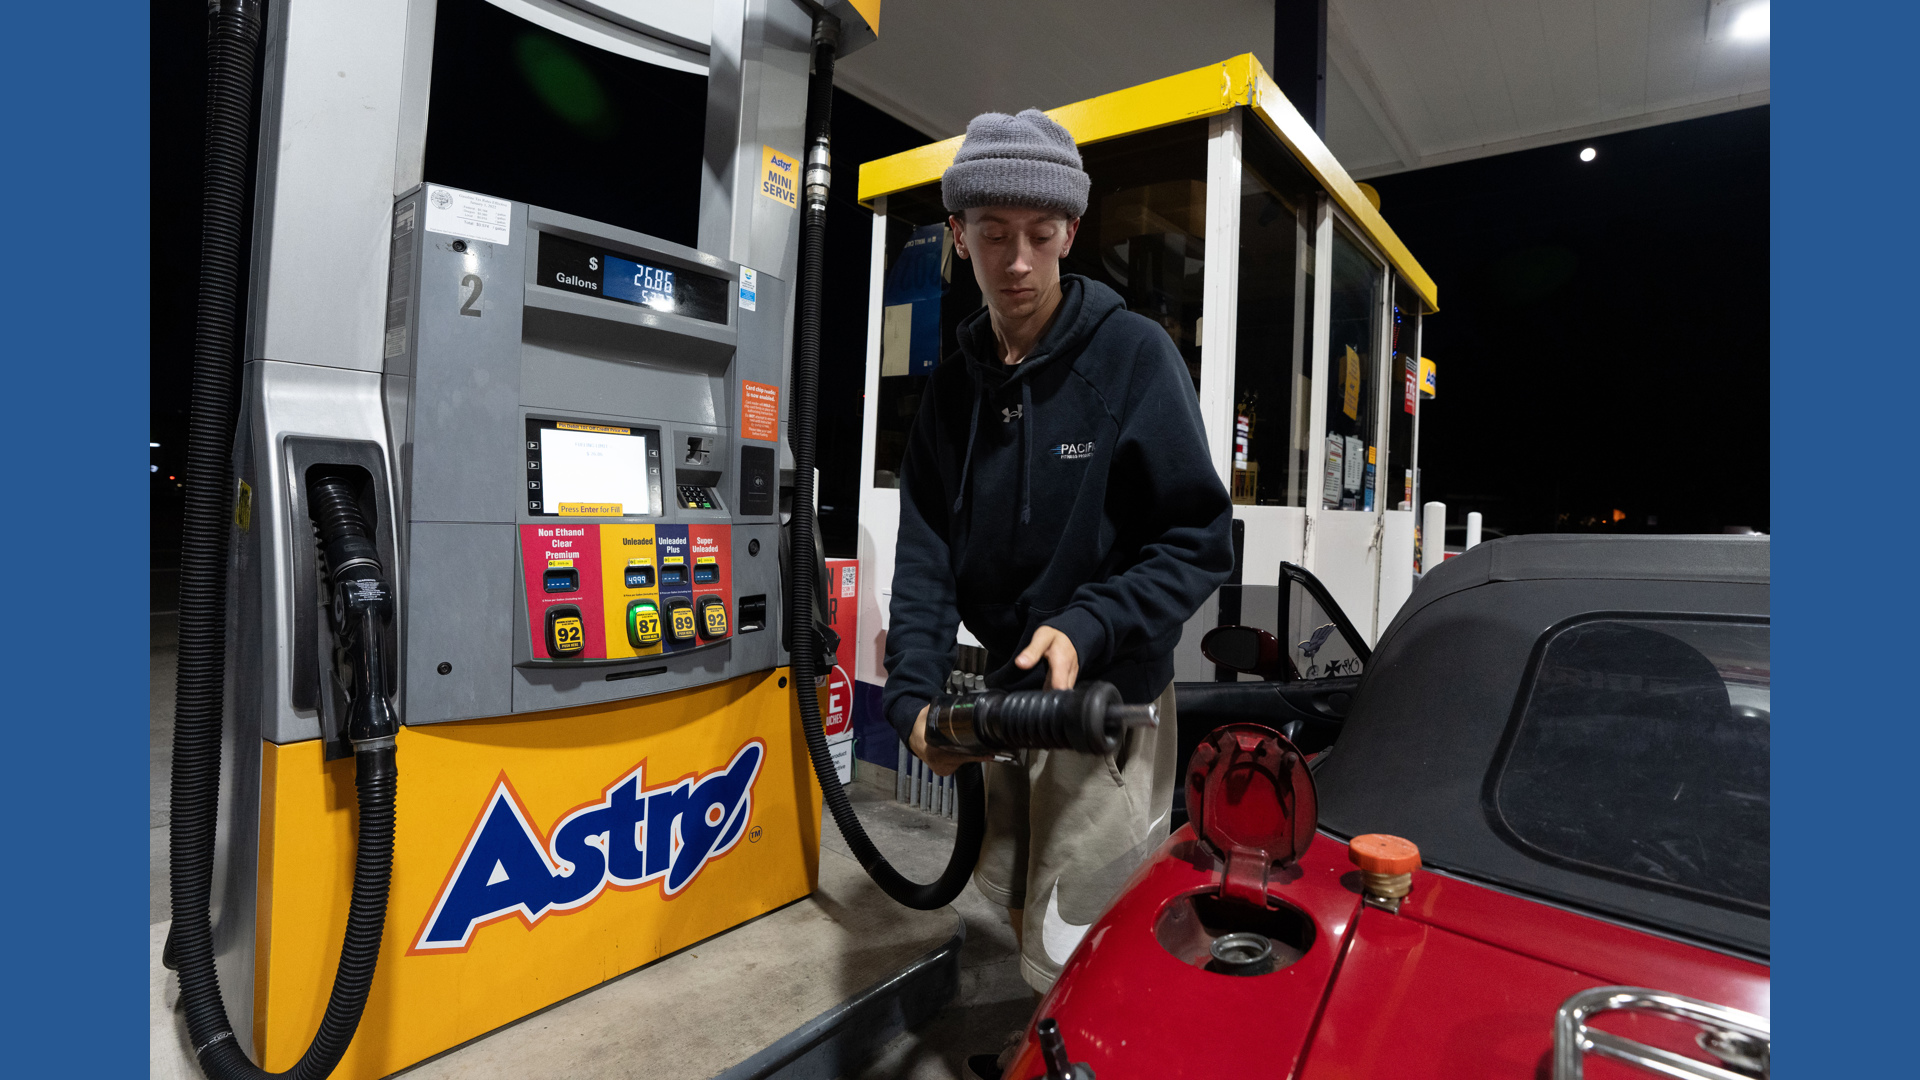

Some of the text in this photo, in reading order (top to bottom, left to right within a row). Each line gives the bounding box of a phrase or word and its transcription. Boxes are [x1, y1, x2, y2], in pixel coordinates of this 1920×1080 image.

[769, 170, 791, 190] MINI
[763, 182, 795, 204] SERVE
[589, 257, 598, 271] $
[556, 272, 598, 290] Gallons
[634, 264, 673, 294] 26.86
[460, 274, 483, 317] 2
[538, 528, 584, 536] Non Ethanol
[552, 539, 572, 548] Clear
[659, 537, 686, 545] Unleaded
[697, 537, 713, 545] Super
[546, 550, 580, 559] Premium
[692, 545, 718, 553] Unleaded
[639, 619, 657, 633] 87
[675, 616, 693, 630] 89
[708, 614, 724, 626] 92
[558, 627, 580, 642] 92
[414, 741, 764, 950] Astro
